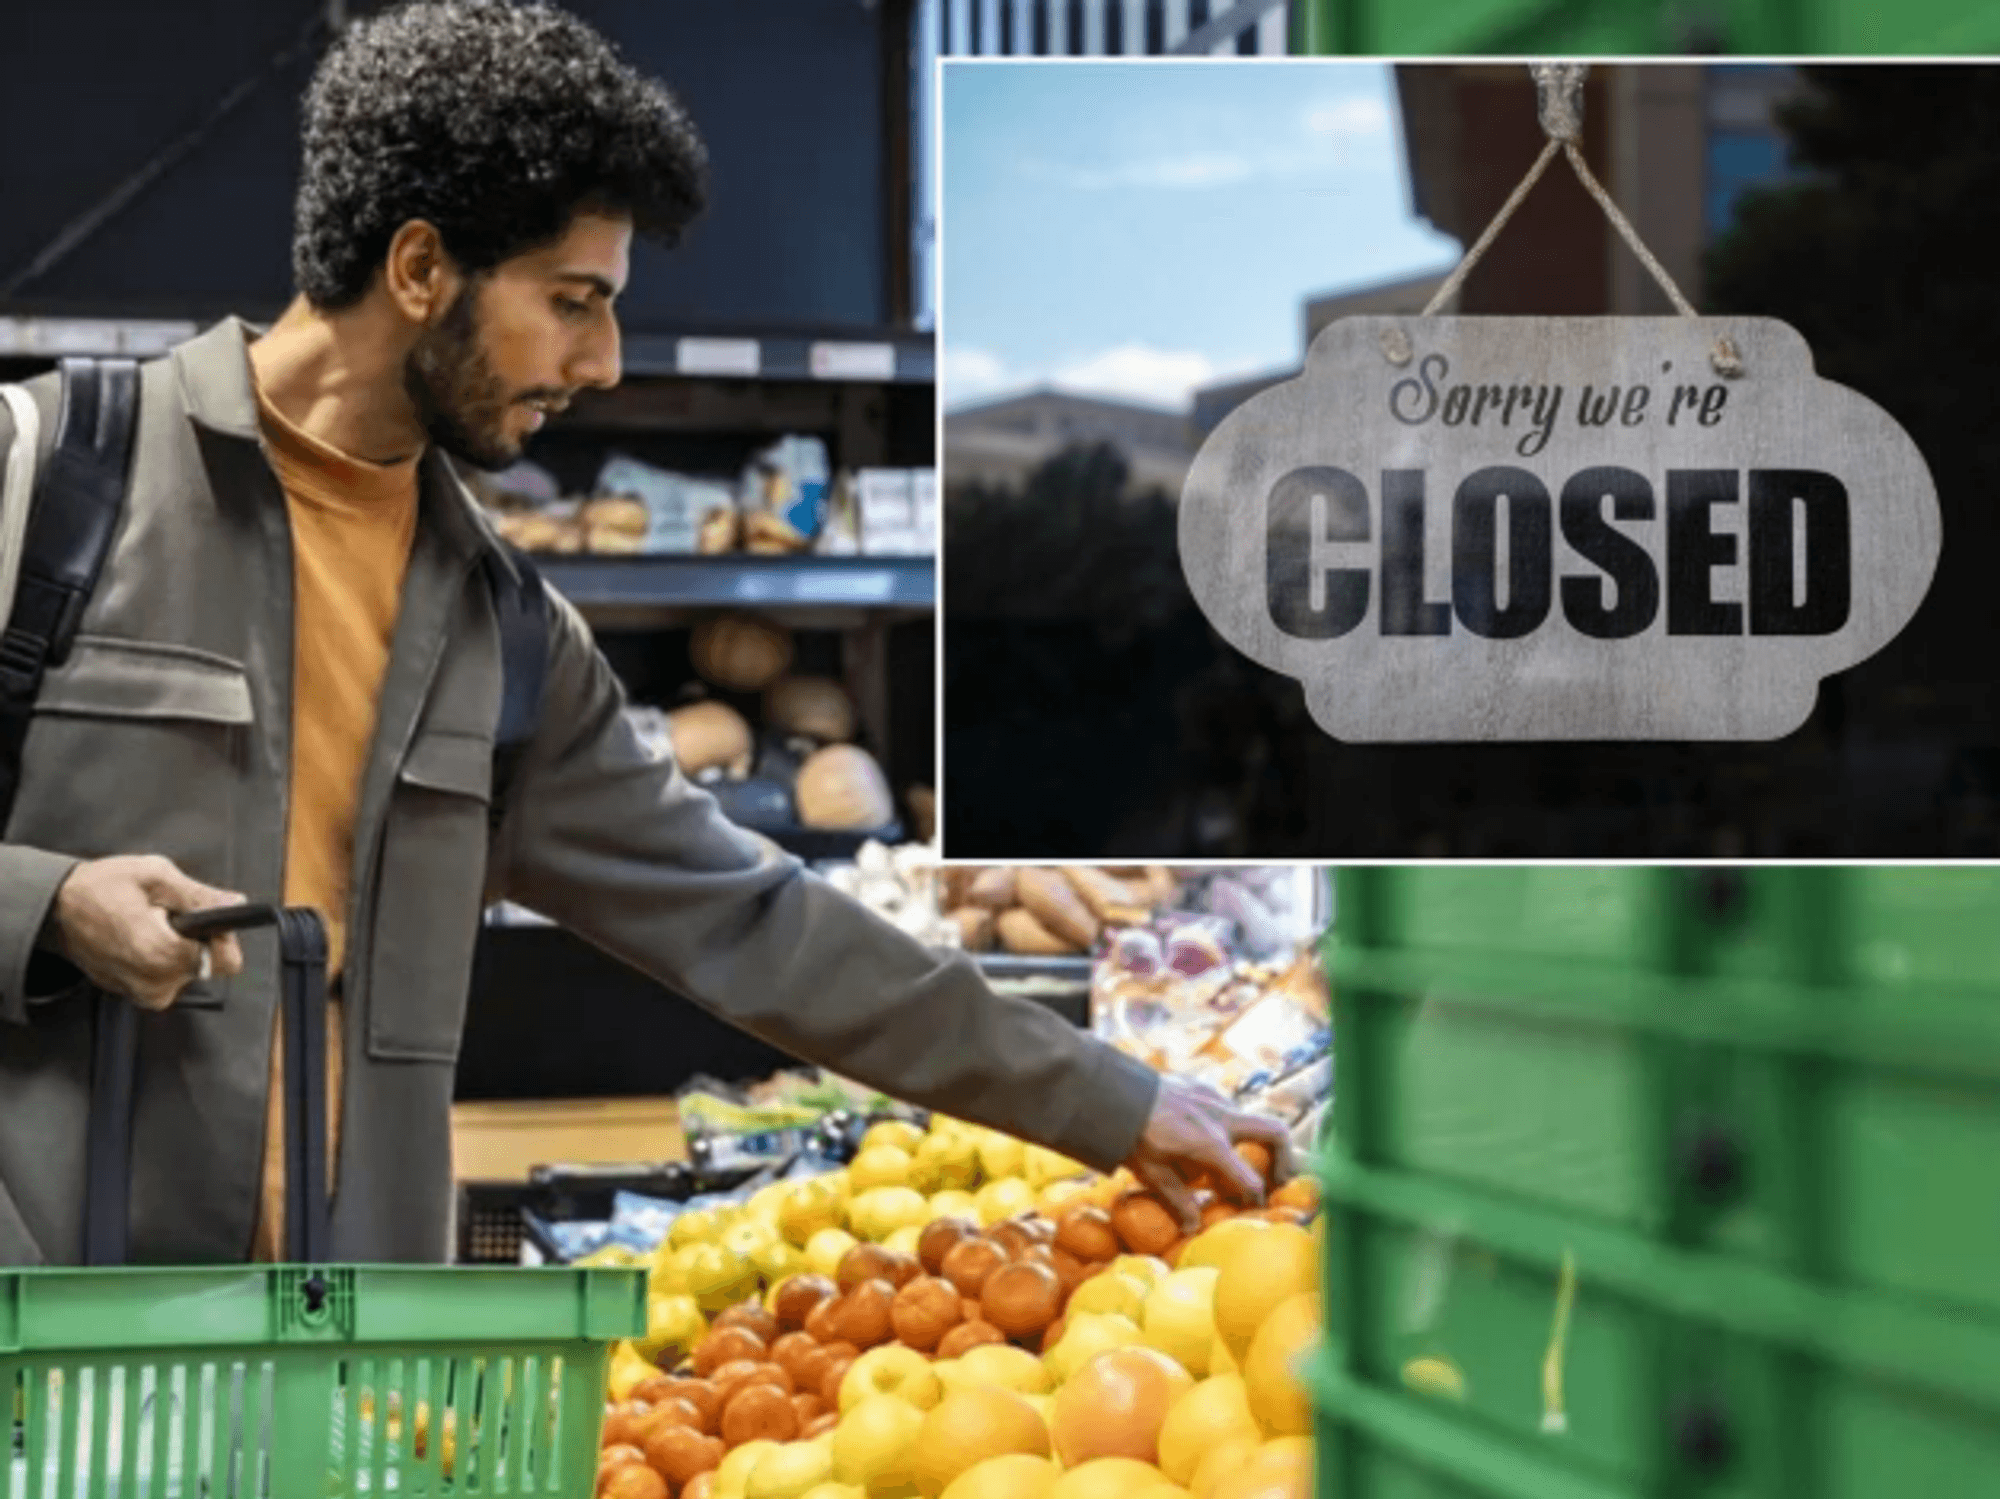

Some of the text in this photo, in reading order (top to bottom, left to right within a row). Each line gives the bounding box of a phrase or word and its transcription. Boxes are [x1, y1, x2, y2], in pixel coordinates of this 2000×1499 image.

[1390, 354, 1729, 457] Sorry we're
[1266, 466, 1851, 639] CLOSED
